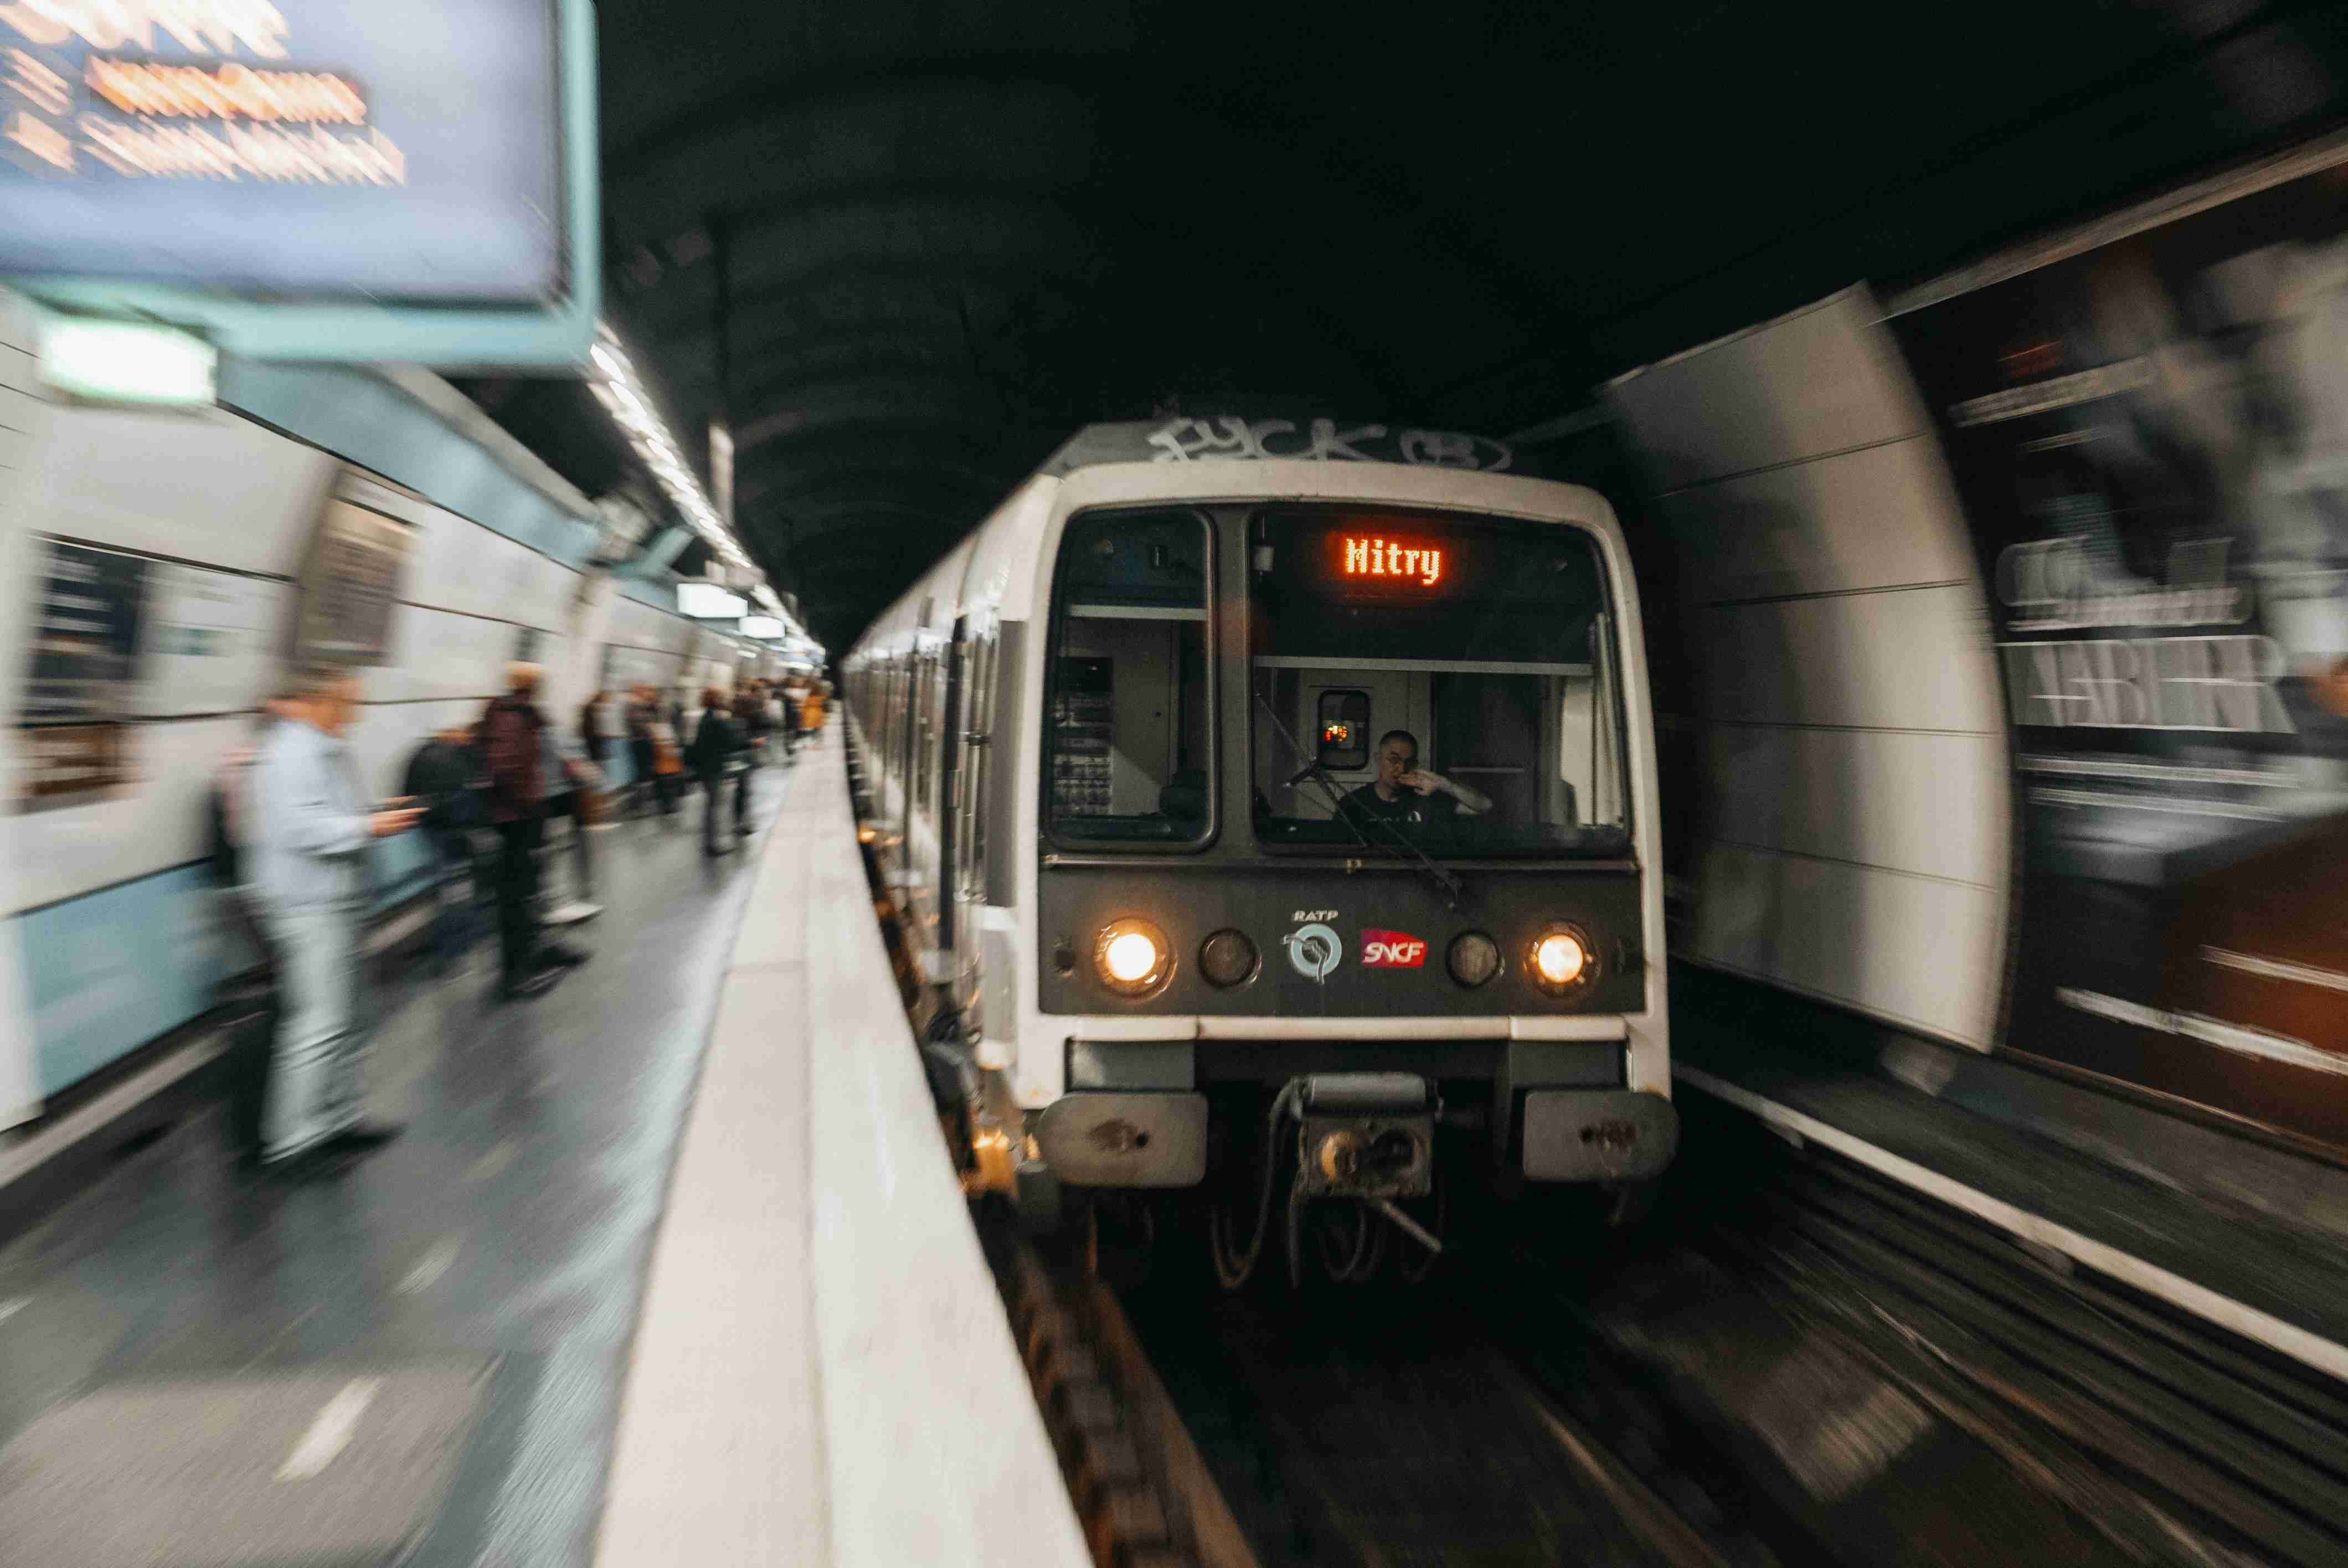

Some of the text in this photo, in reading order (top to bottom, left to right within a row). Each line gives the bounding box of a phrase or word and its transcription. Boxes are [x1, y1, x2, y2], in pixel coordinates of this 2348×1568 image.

[1346, 538, 1440, 585] Mitry
[1294, 910, 1338, 921] RATP
[1361, 942, 1424, 963] SNCF
